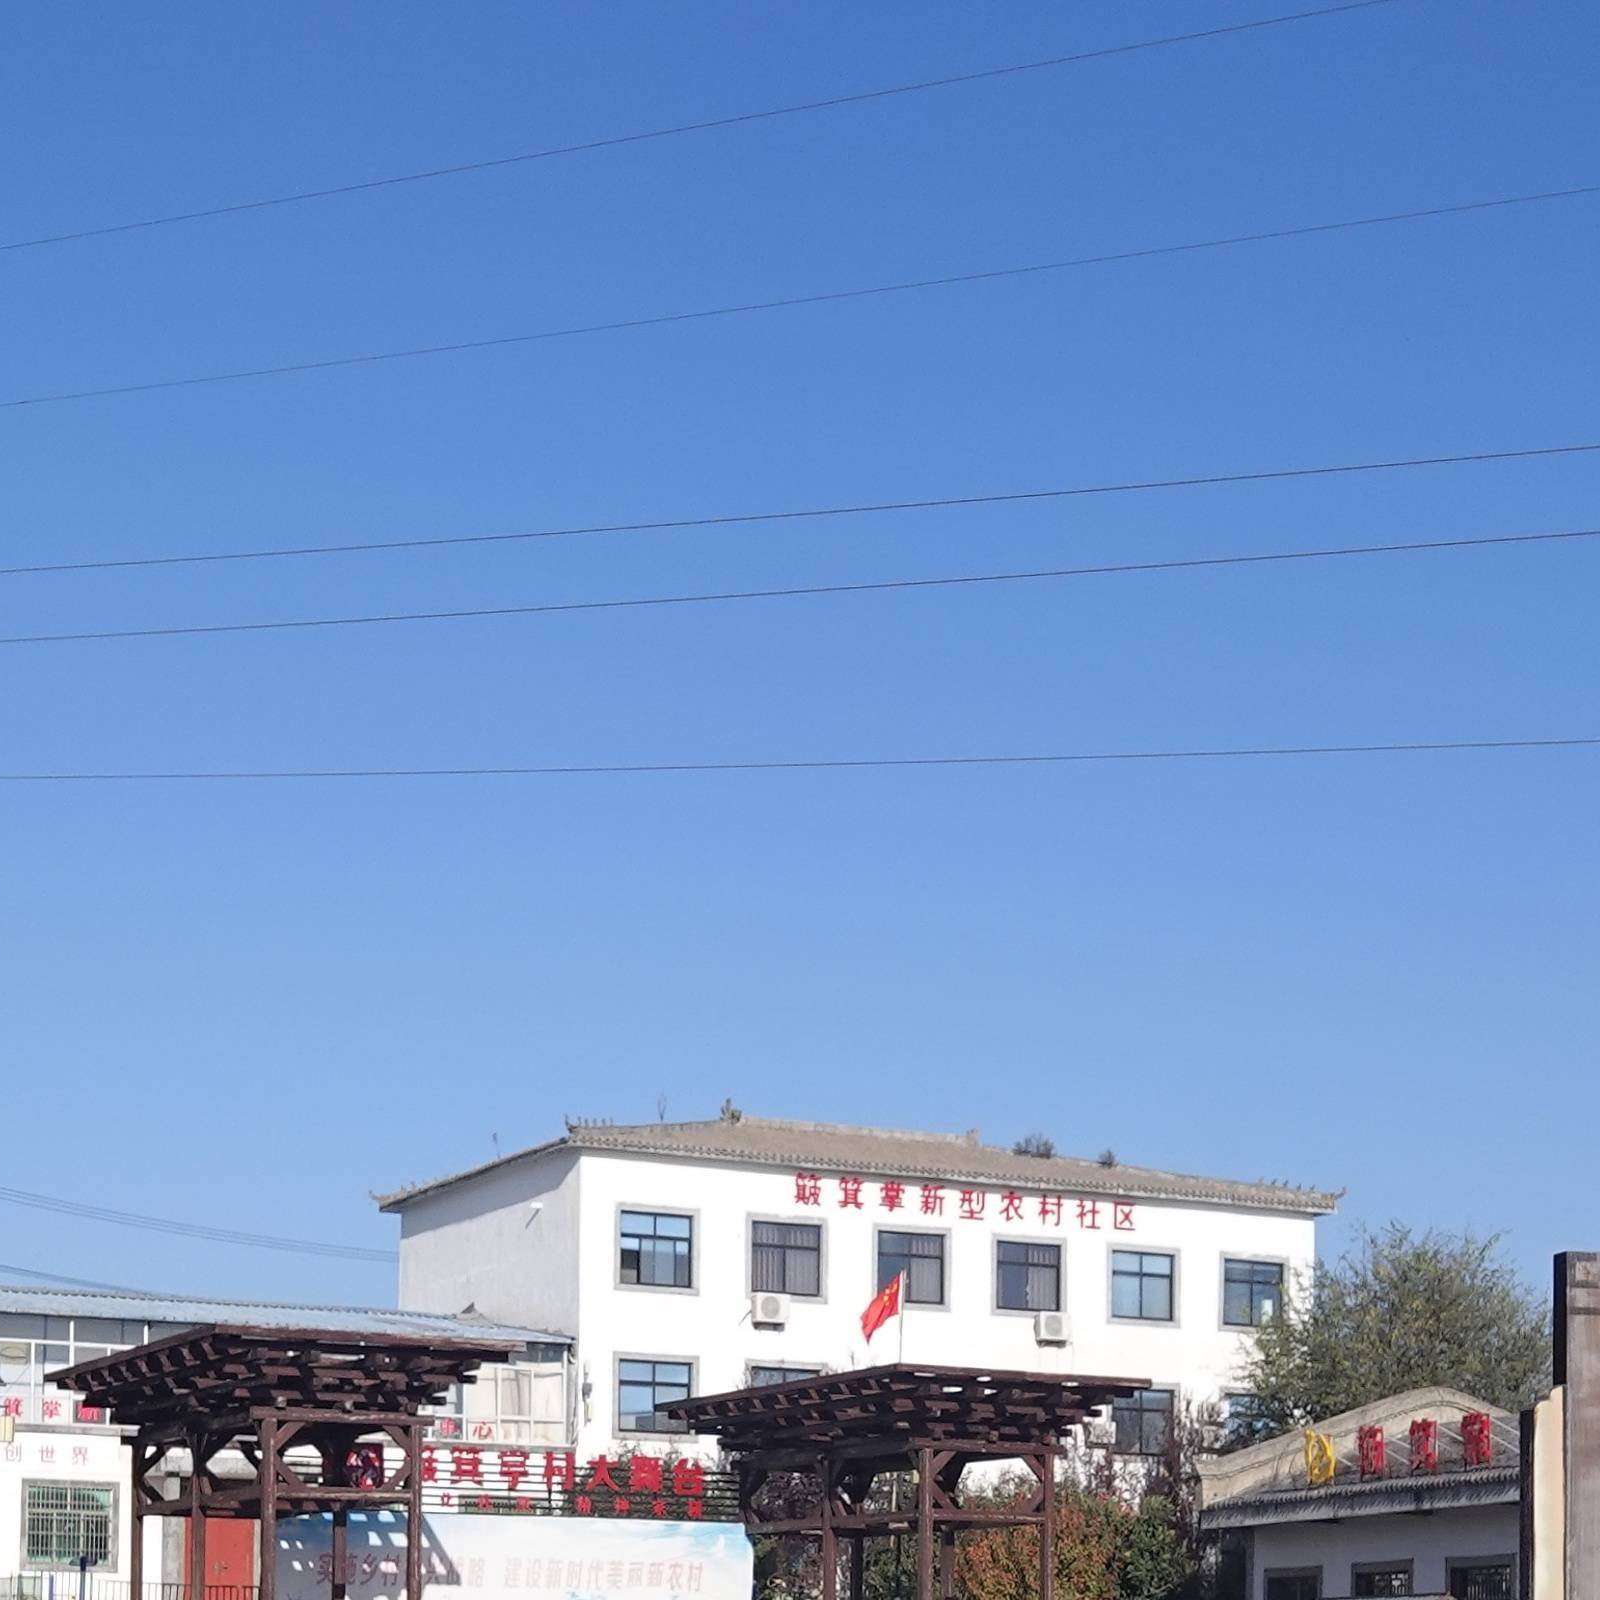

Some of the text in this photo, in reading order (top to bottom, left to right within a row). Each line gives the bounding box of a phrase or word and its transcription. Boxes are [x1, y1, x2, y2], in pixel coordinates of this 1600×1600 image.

[795, 1172, 1136, 1231] 簸箕掌新型农村社区
